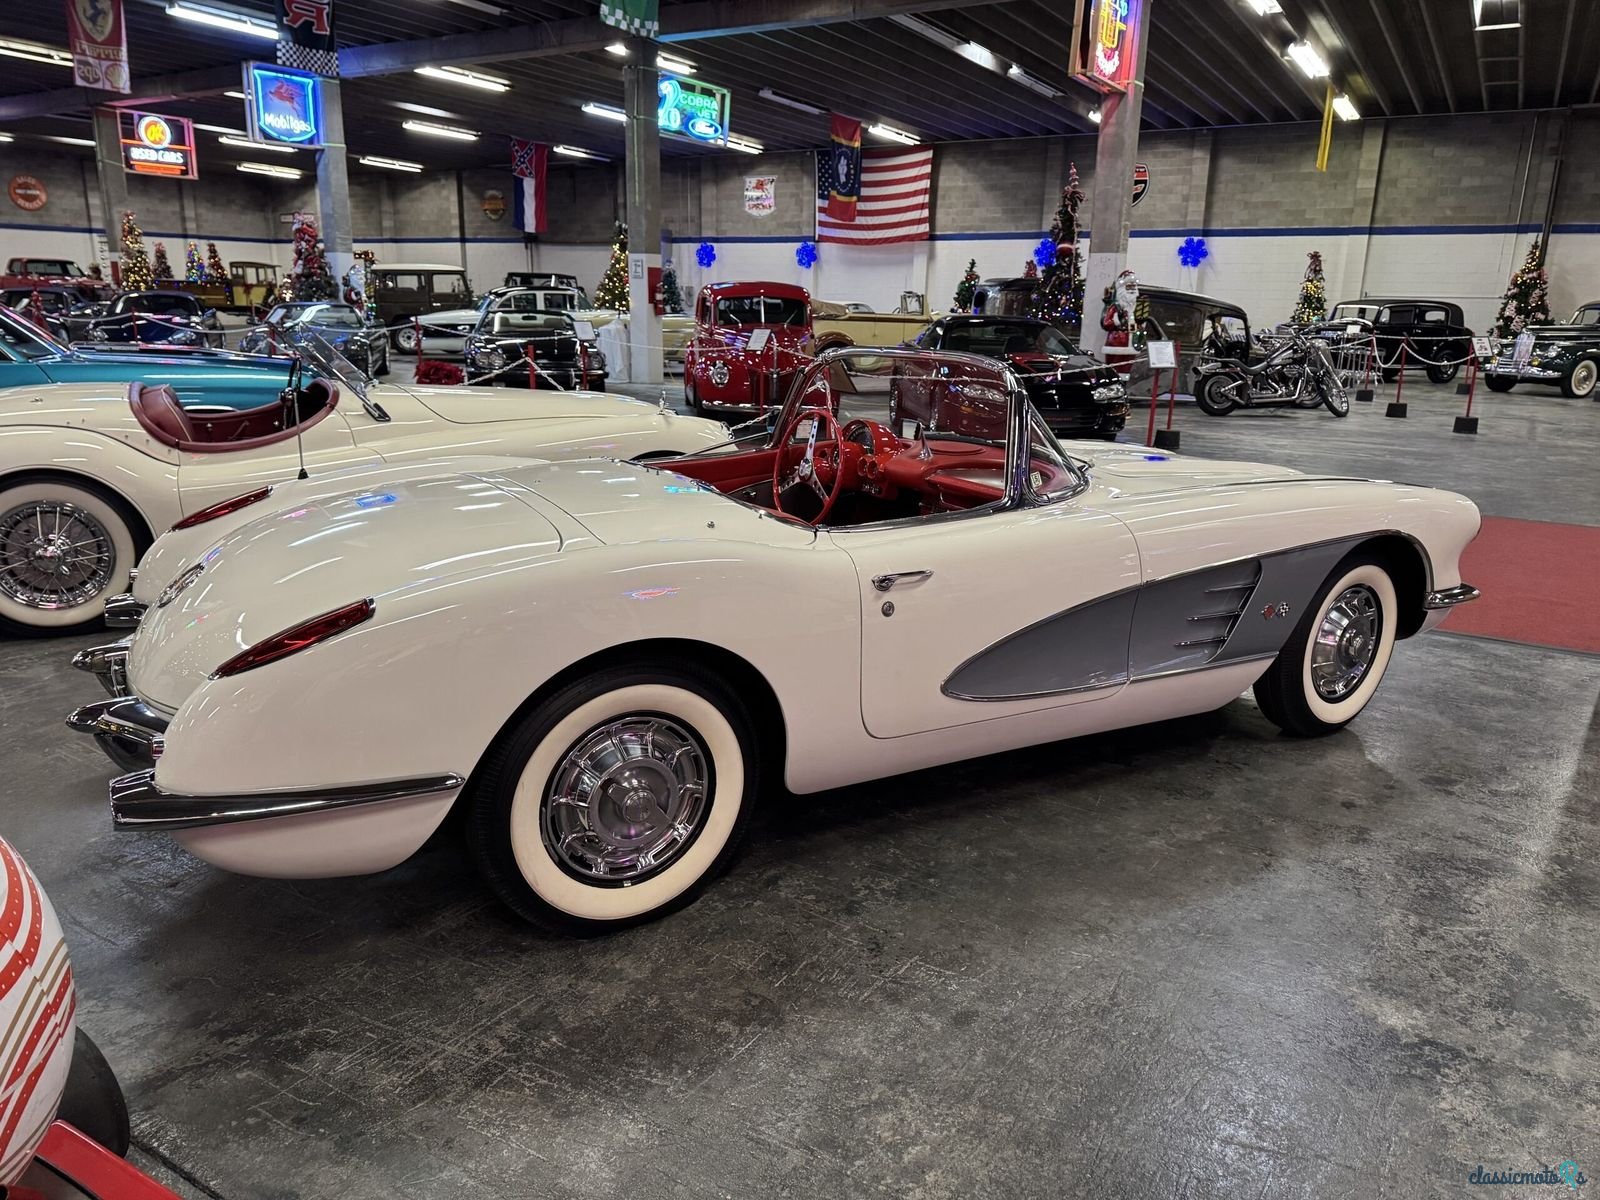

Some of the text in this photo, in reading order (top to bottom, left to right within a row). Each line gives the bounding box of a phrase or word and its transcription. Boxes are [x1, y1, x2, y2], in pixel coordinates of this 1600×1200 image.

[680, 93, 719, 110] COBRA
[698, 107, 718, 120] JET
[264, 112, 312, 134] Mobilgas
[147, 123, 166, 142] OK
